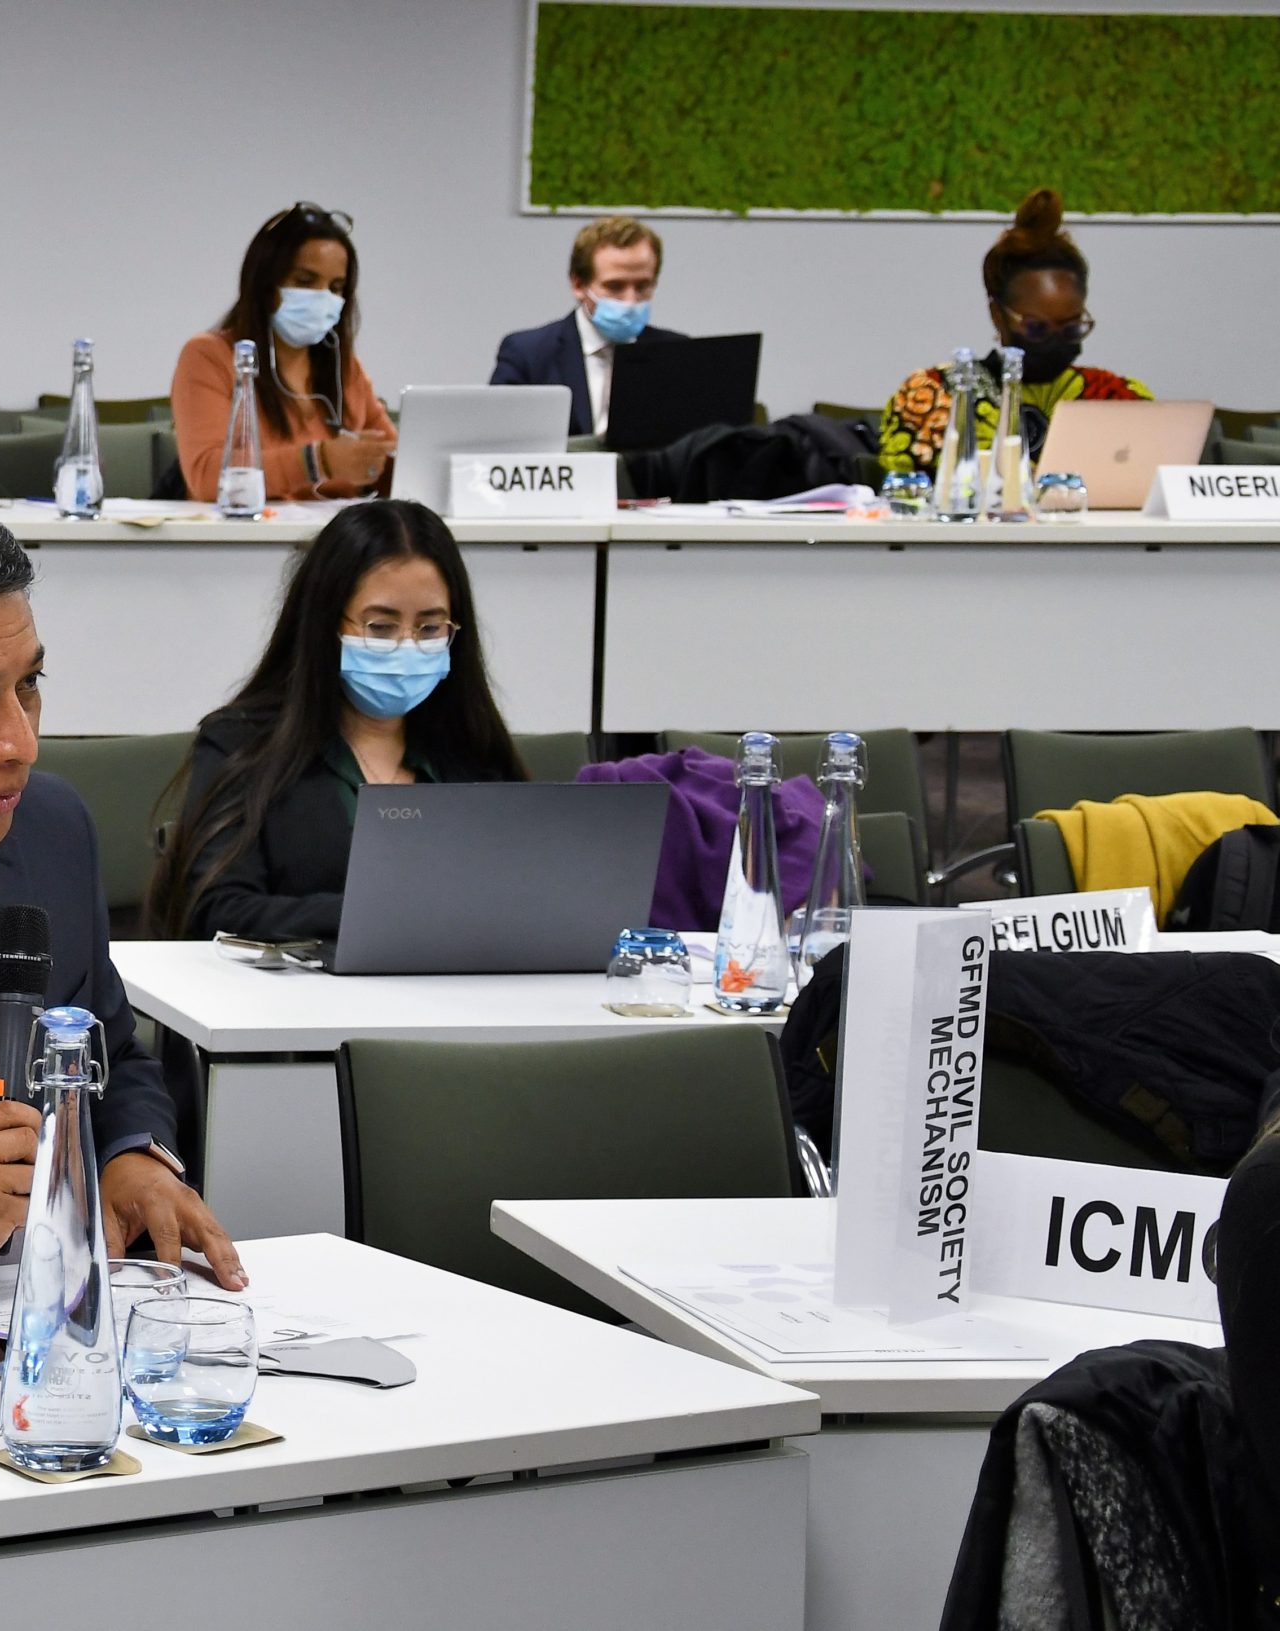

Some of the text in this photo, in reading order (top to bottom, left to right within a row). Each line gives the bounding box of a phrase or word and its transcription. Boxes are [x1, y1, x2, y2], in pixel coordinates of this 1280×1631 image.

[489, 465, 574, 492] QATAR
[1189, 475, 1279, 497] NIGERI
[378, 807, 422, 820] YOGA
[991, 906, 1127, 953] BELGIUM
[917, 1015, 955, 1237] MECHANISM
[937, 935, 986, 1304] GFMD CIVIL SOCIETY
